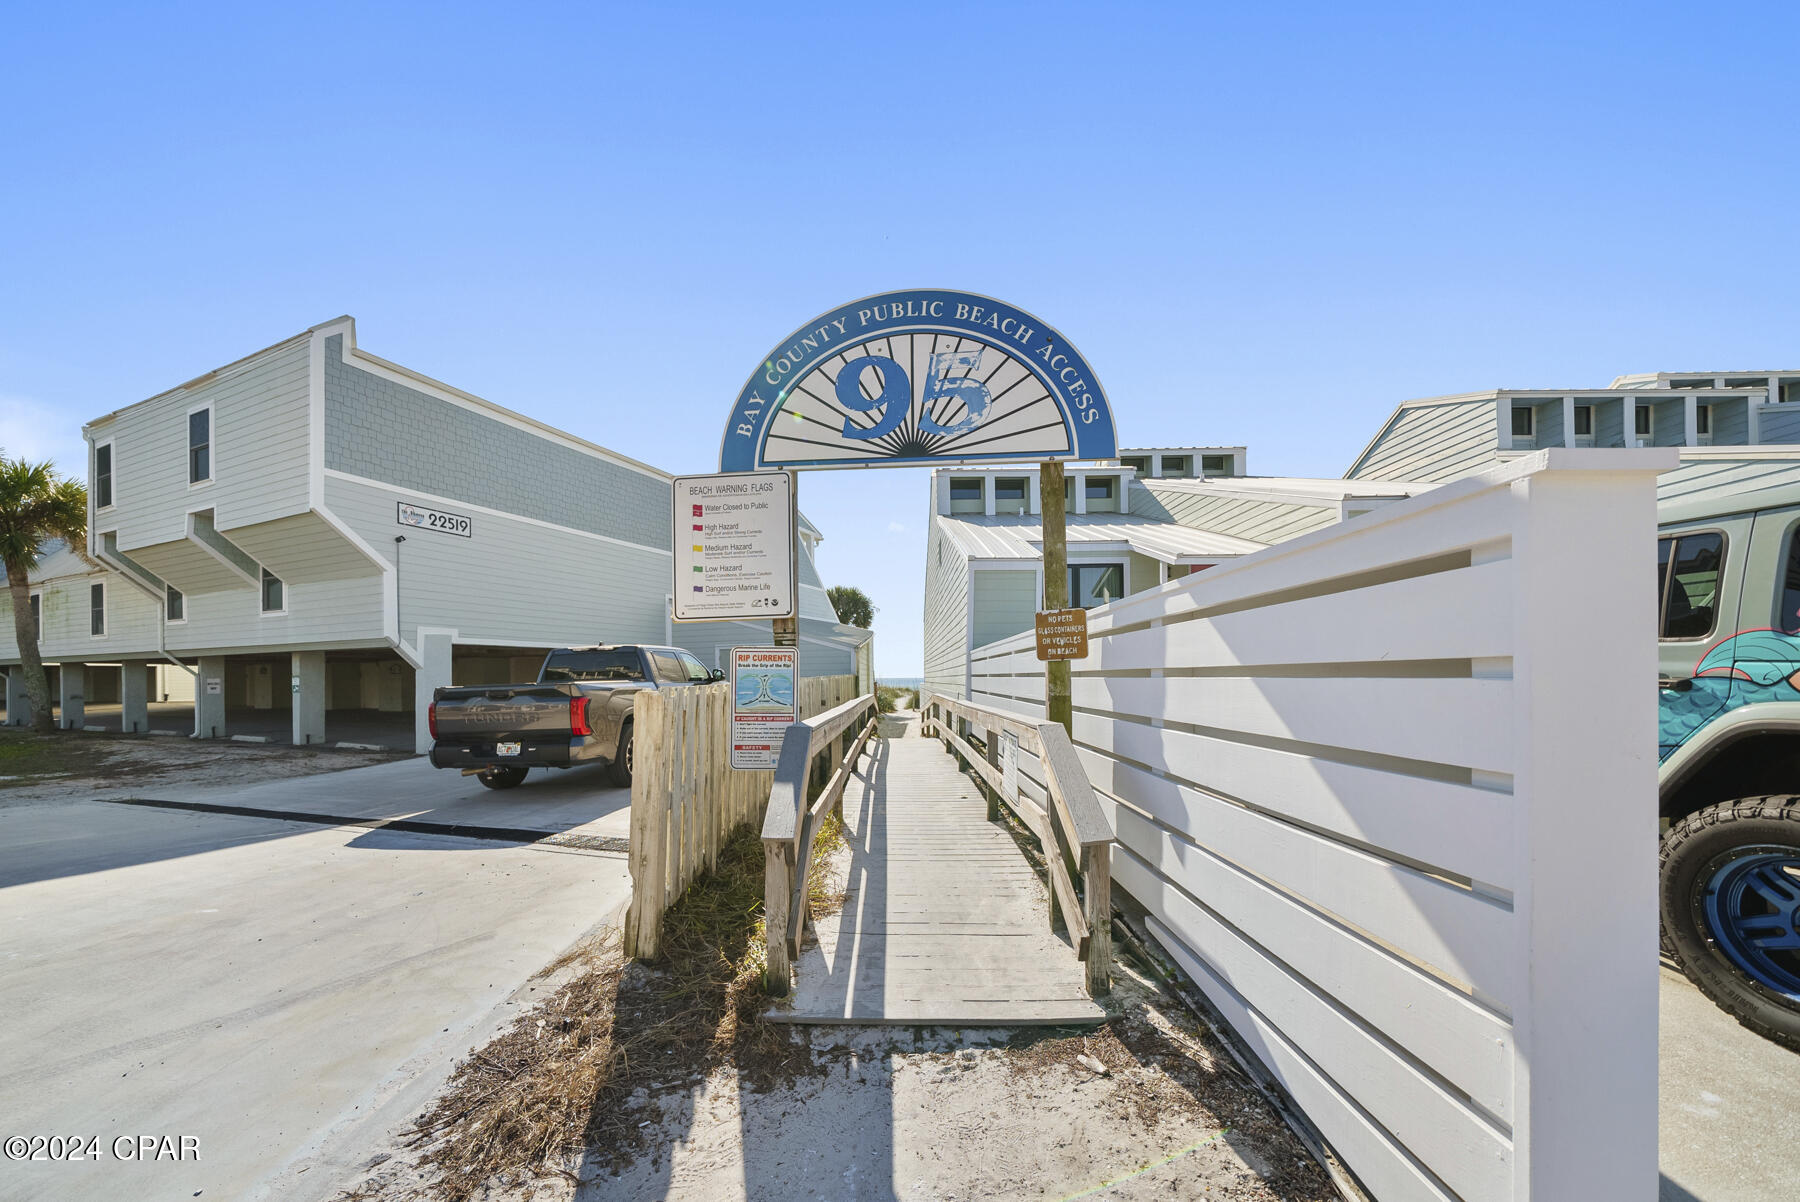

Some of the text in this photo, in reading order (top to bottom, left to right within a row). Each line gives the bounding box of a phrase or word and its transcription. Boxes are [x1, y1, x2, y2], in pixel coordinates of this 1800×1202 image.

[735, 300, 1099, 440] BAY COUNTY PUBLIC BEACH ACCESS
[834, 349, 994, 440] 95
[689, 486, 712, 496] BEACH
[716, 484, 748, 494] WARNING
[751, 483, 774, 492] FLAGS
[704, 504, 721, 512] Water
[722, 503, 743, 511] Closed
[751, 502, 769, 510] Public
[428, 513, 468, 532] 22519
[704, 524, 718, 532] High
[704, 544, 729, 552] Medium
[719, 564, 743, 572] Hazard
[705, 585, 737, 593] Dangerous
[759, 583, 771, 591] Life
[1048, 615, 1056, 623] NO
[1038, 625, 1085, 635] GLASS CONTAINERS
[1042, 637, 1051, 645] OR
[1047, 647, 1078, 656] ON BEACH
[738, 654, 792, 662] RIP CURRENTS
[461, 712, 540, 724] TUNDRA
